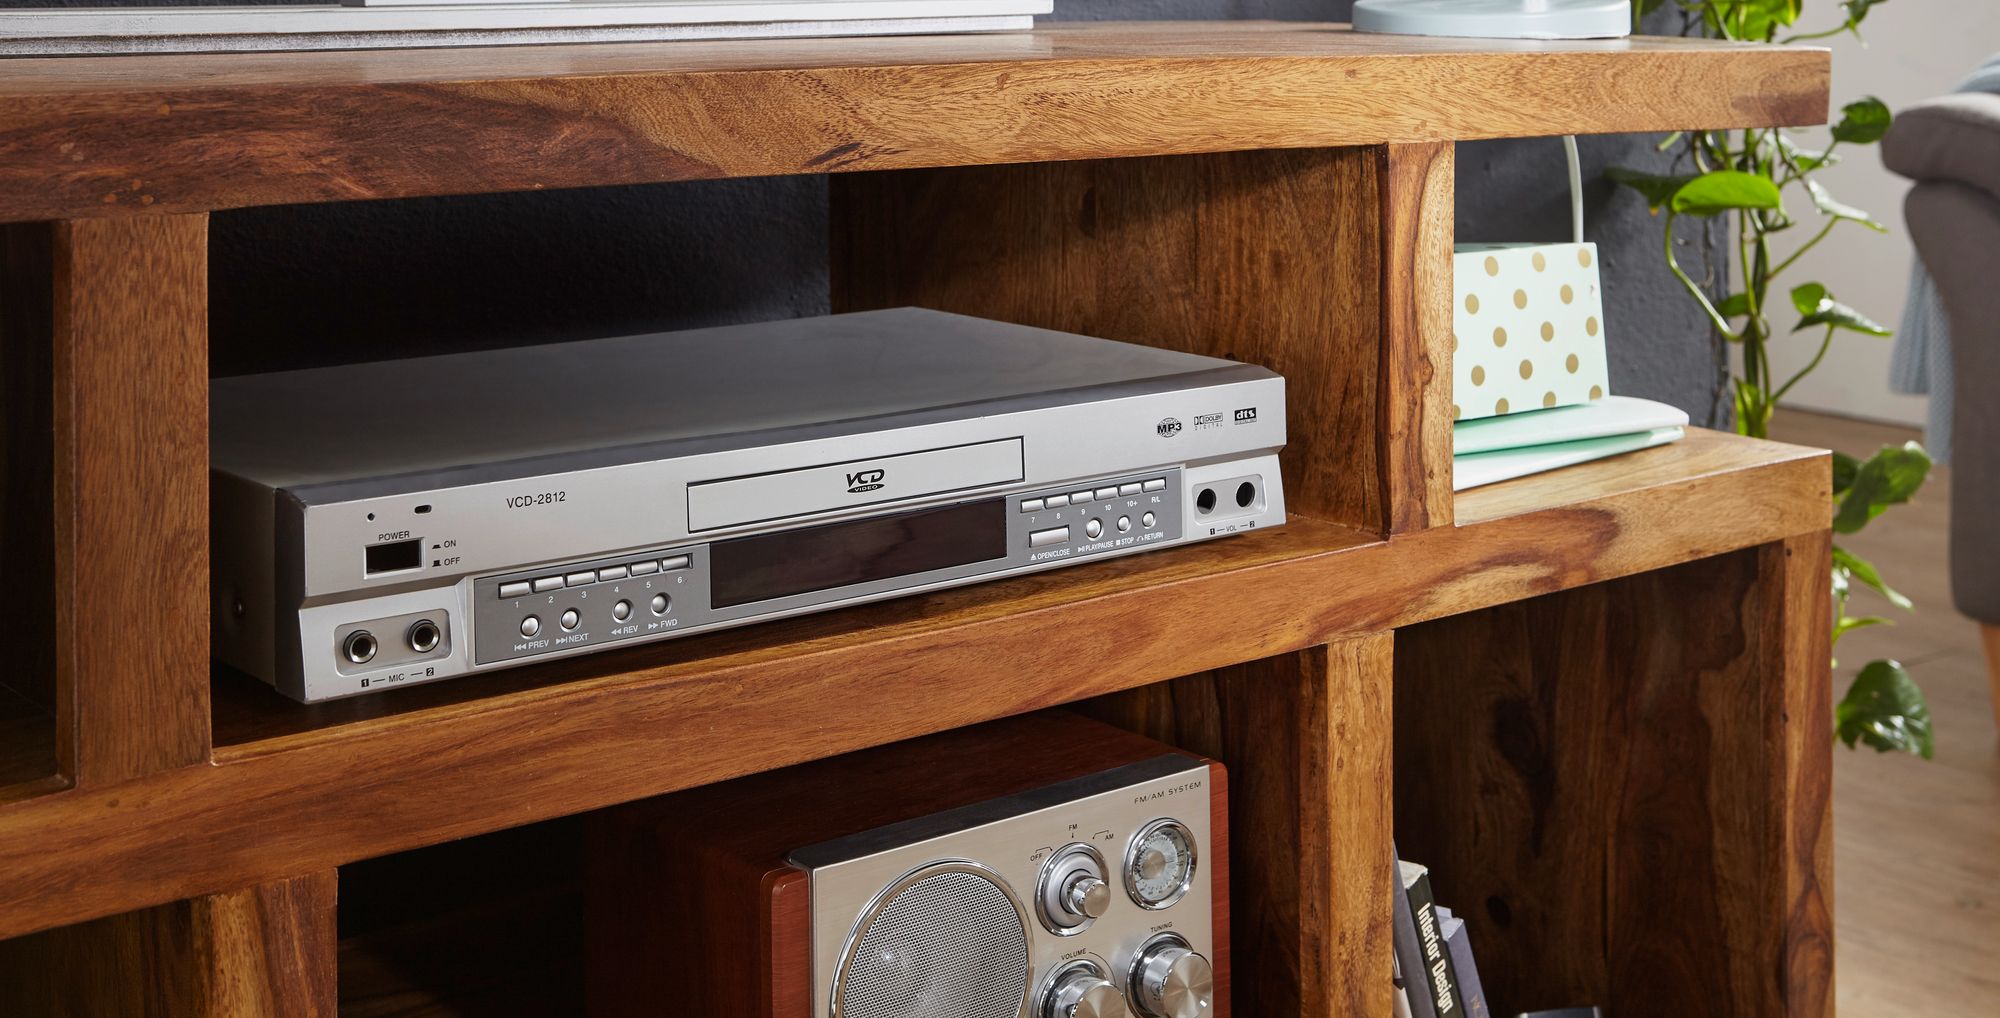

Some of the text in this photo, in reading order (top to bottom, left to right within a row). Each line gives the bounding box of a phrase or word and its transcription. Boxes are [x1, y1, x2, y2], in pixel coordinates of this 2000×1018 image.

[1235, 409, 1256, 420] dts
[1157, 422, 1182, 433] MP3
[846, 468, 885, 488] VCD
[854, 484, 878, 492] VIDEO
[506, 491, 566, 509] VCD-2812
[1226, 524, 1237, 532] VOL
[378, 530, 410, 542] POWER
[1121, 536, 1135, 545] STOP
[1144, 531, 1164, 541] RETURN
[443, 540, 457, 549] ON
[1085, 540, 1114, 552] PLAY/PAUSE
[1037, 548, 1071, 560] OPEN/CLOSE
[443, 556, 461, 567] OFF
[548, 595, 554, 604] 2
[581, 590, 587, 599] 3
[646, 581, 652, 589] 5
[677, 576, 683, 584] 6
[660, 618, 678, 629] FWD
[623, 624, 639, 635] REV
[568, 632, 590, 644] NEXT
[528, 639, 550, 650] PREV
[388, 673, 405, 683] MIC
[1134, 780, 1202, 805] FM/AM SYSTEM
[1068, 823, 1078, 831] FM
[1104, 833, 1114, 841] AM
[1030, 852, 1043, 862] OFF
[1150, 921, 1173, 933] TUNING
[1061, 947, 1087, 961] VOLUME
[1417, 902, 1454, 1014] Interior Design
